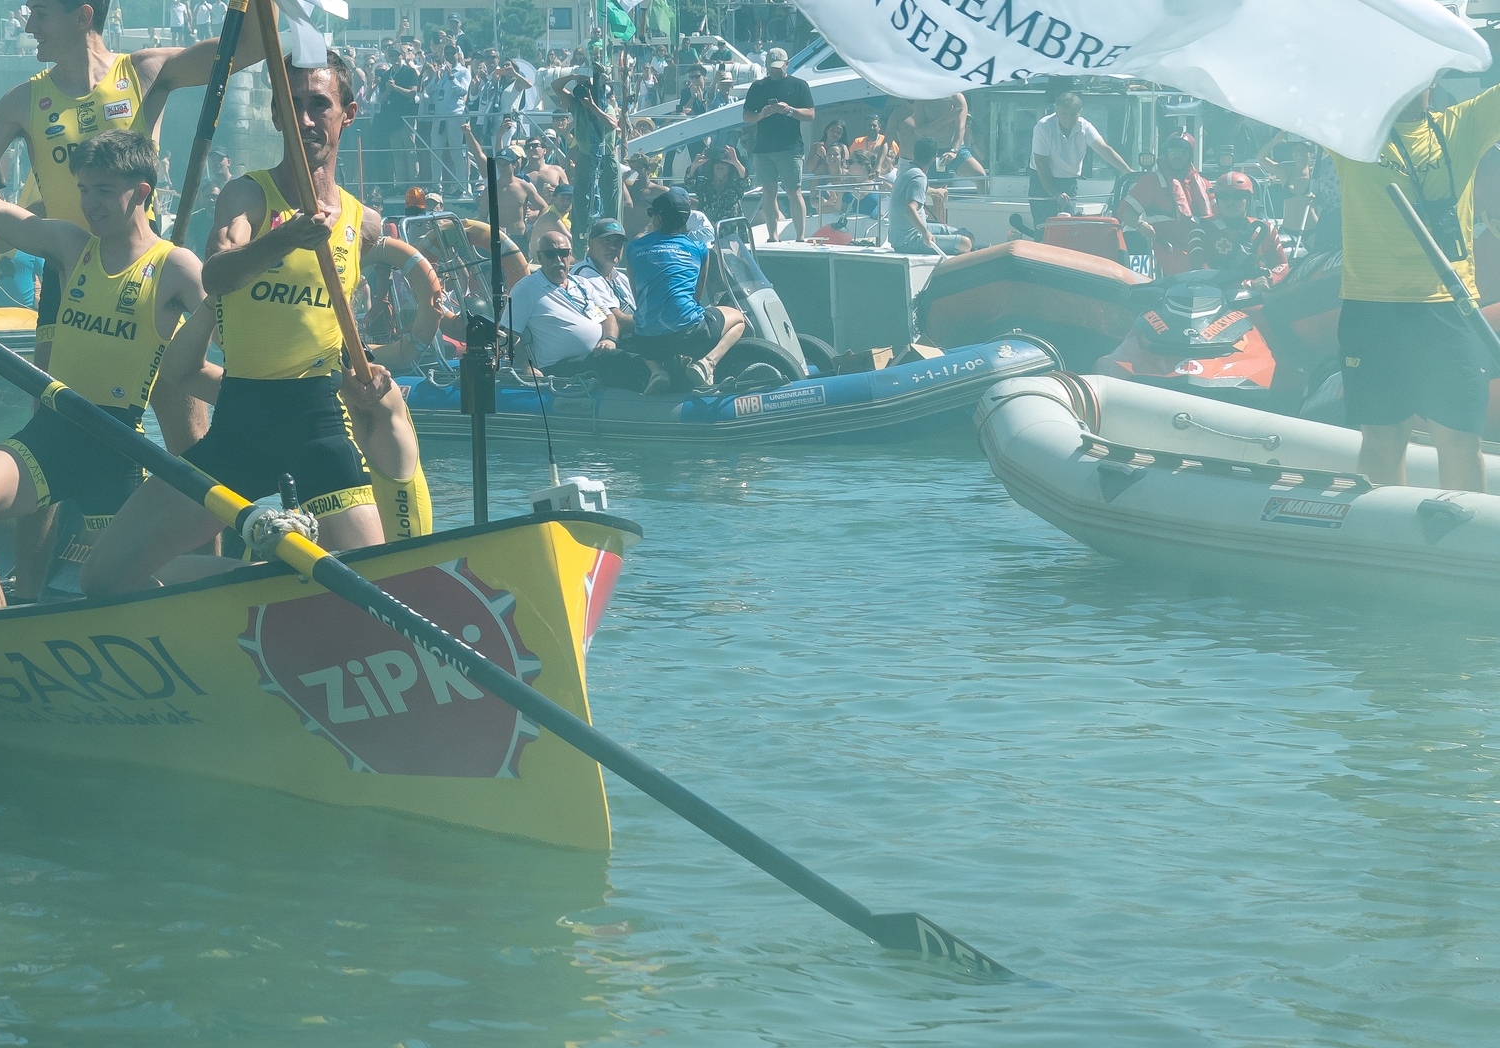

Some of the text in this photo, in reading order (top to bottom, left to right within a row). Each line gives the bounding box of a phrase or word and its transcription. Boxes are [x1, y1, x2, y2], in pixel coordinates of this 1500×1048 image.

[62, 307, 138, 341] ORIALKI
[143, 343, 166, 388] Loiola
[739, 395, 761, 416] WB
[763, 396, 824, 411] INSUBMERSIBLE
[396, 489, 411, 538] Loiola
[1282, 499, 1347, 518] NARWHAL
